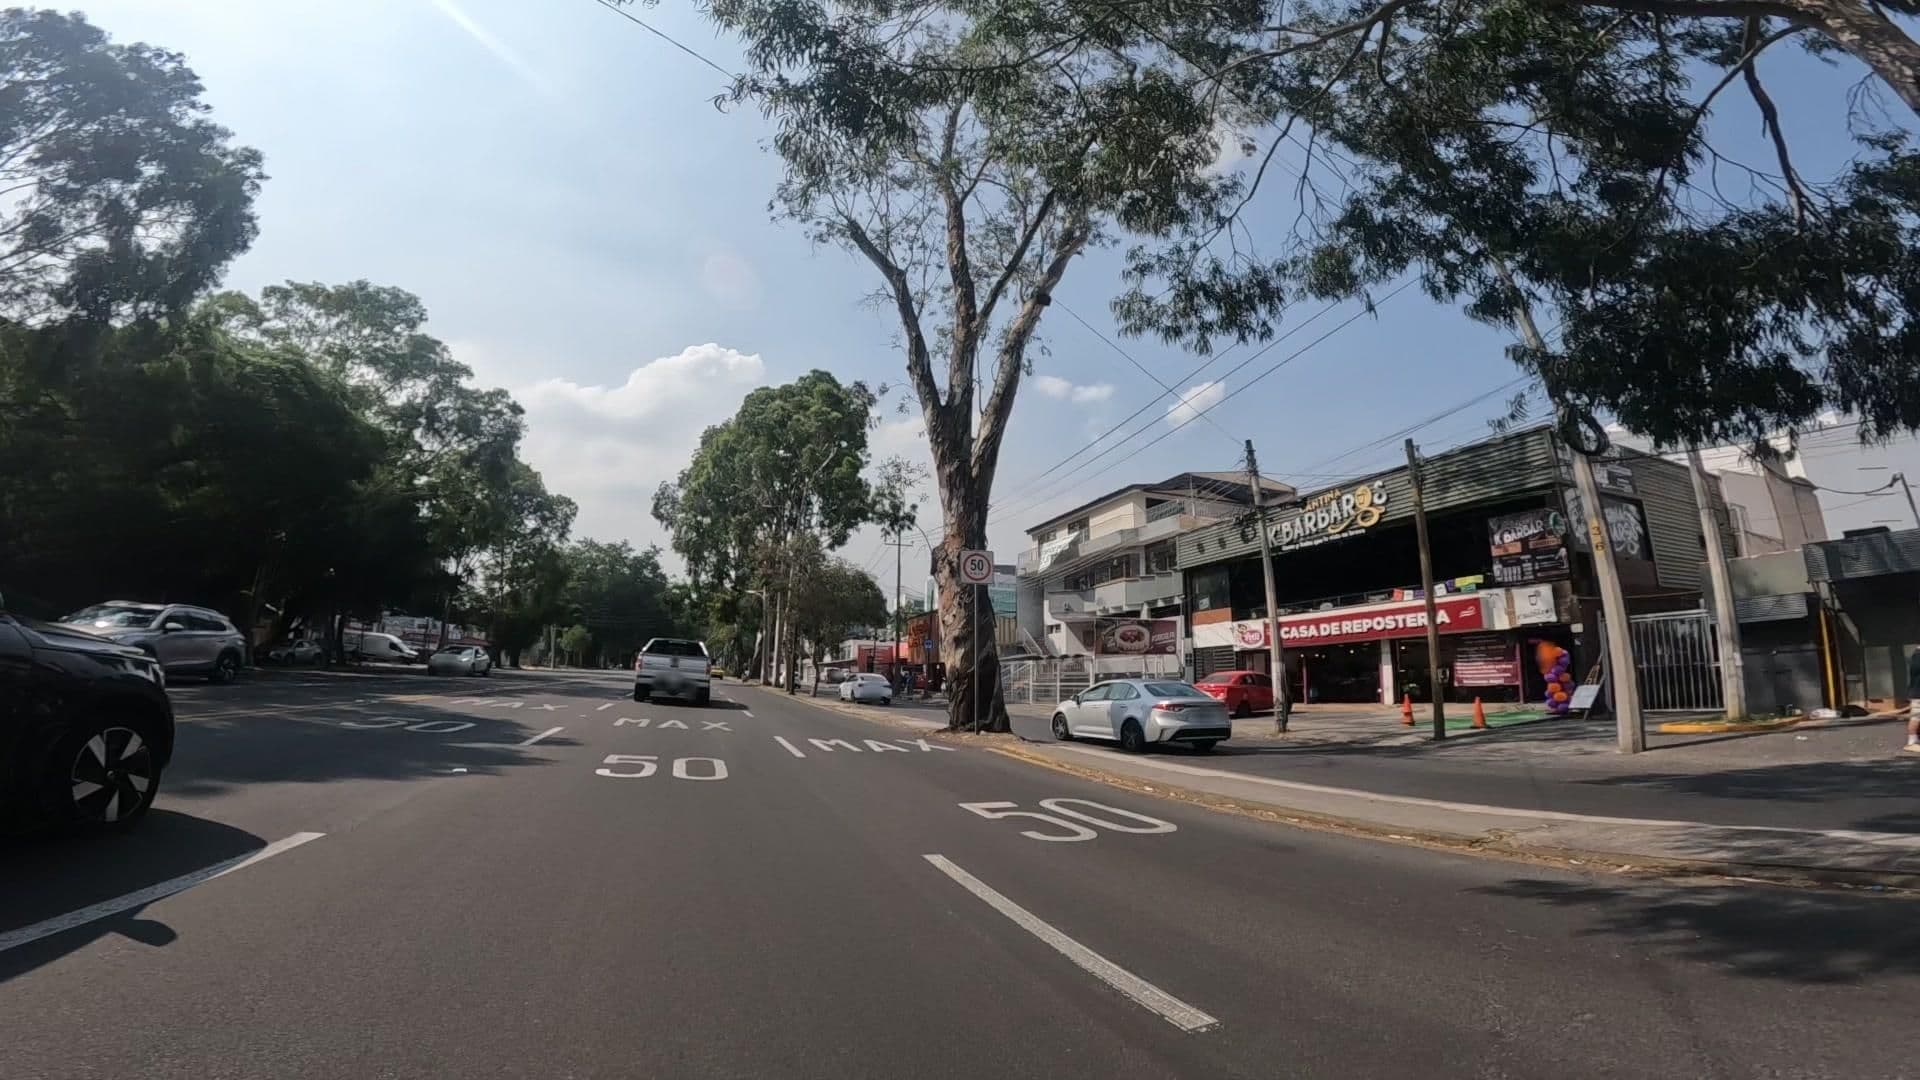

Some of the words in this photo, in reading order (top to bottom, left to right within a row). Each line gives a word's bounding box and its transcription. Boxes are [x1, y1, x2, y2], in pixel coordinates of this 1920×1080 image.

[970, 559, 984, 571] 50
[1280, 624, 1319, 641] CASA
[1319, 621, 1340, 637] DE
[1341, 609, 1451, 634] REPOSTERA
[340, 716, 478, 733] 50
[613, 717, 734, 731] MAX
[807, 737, 957, 753] MAX
[595, 754, 729, 781] 50
[957, 798, 1178, 842] 50
